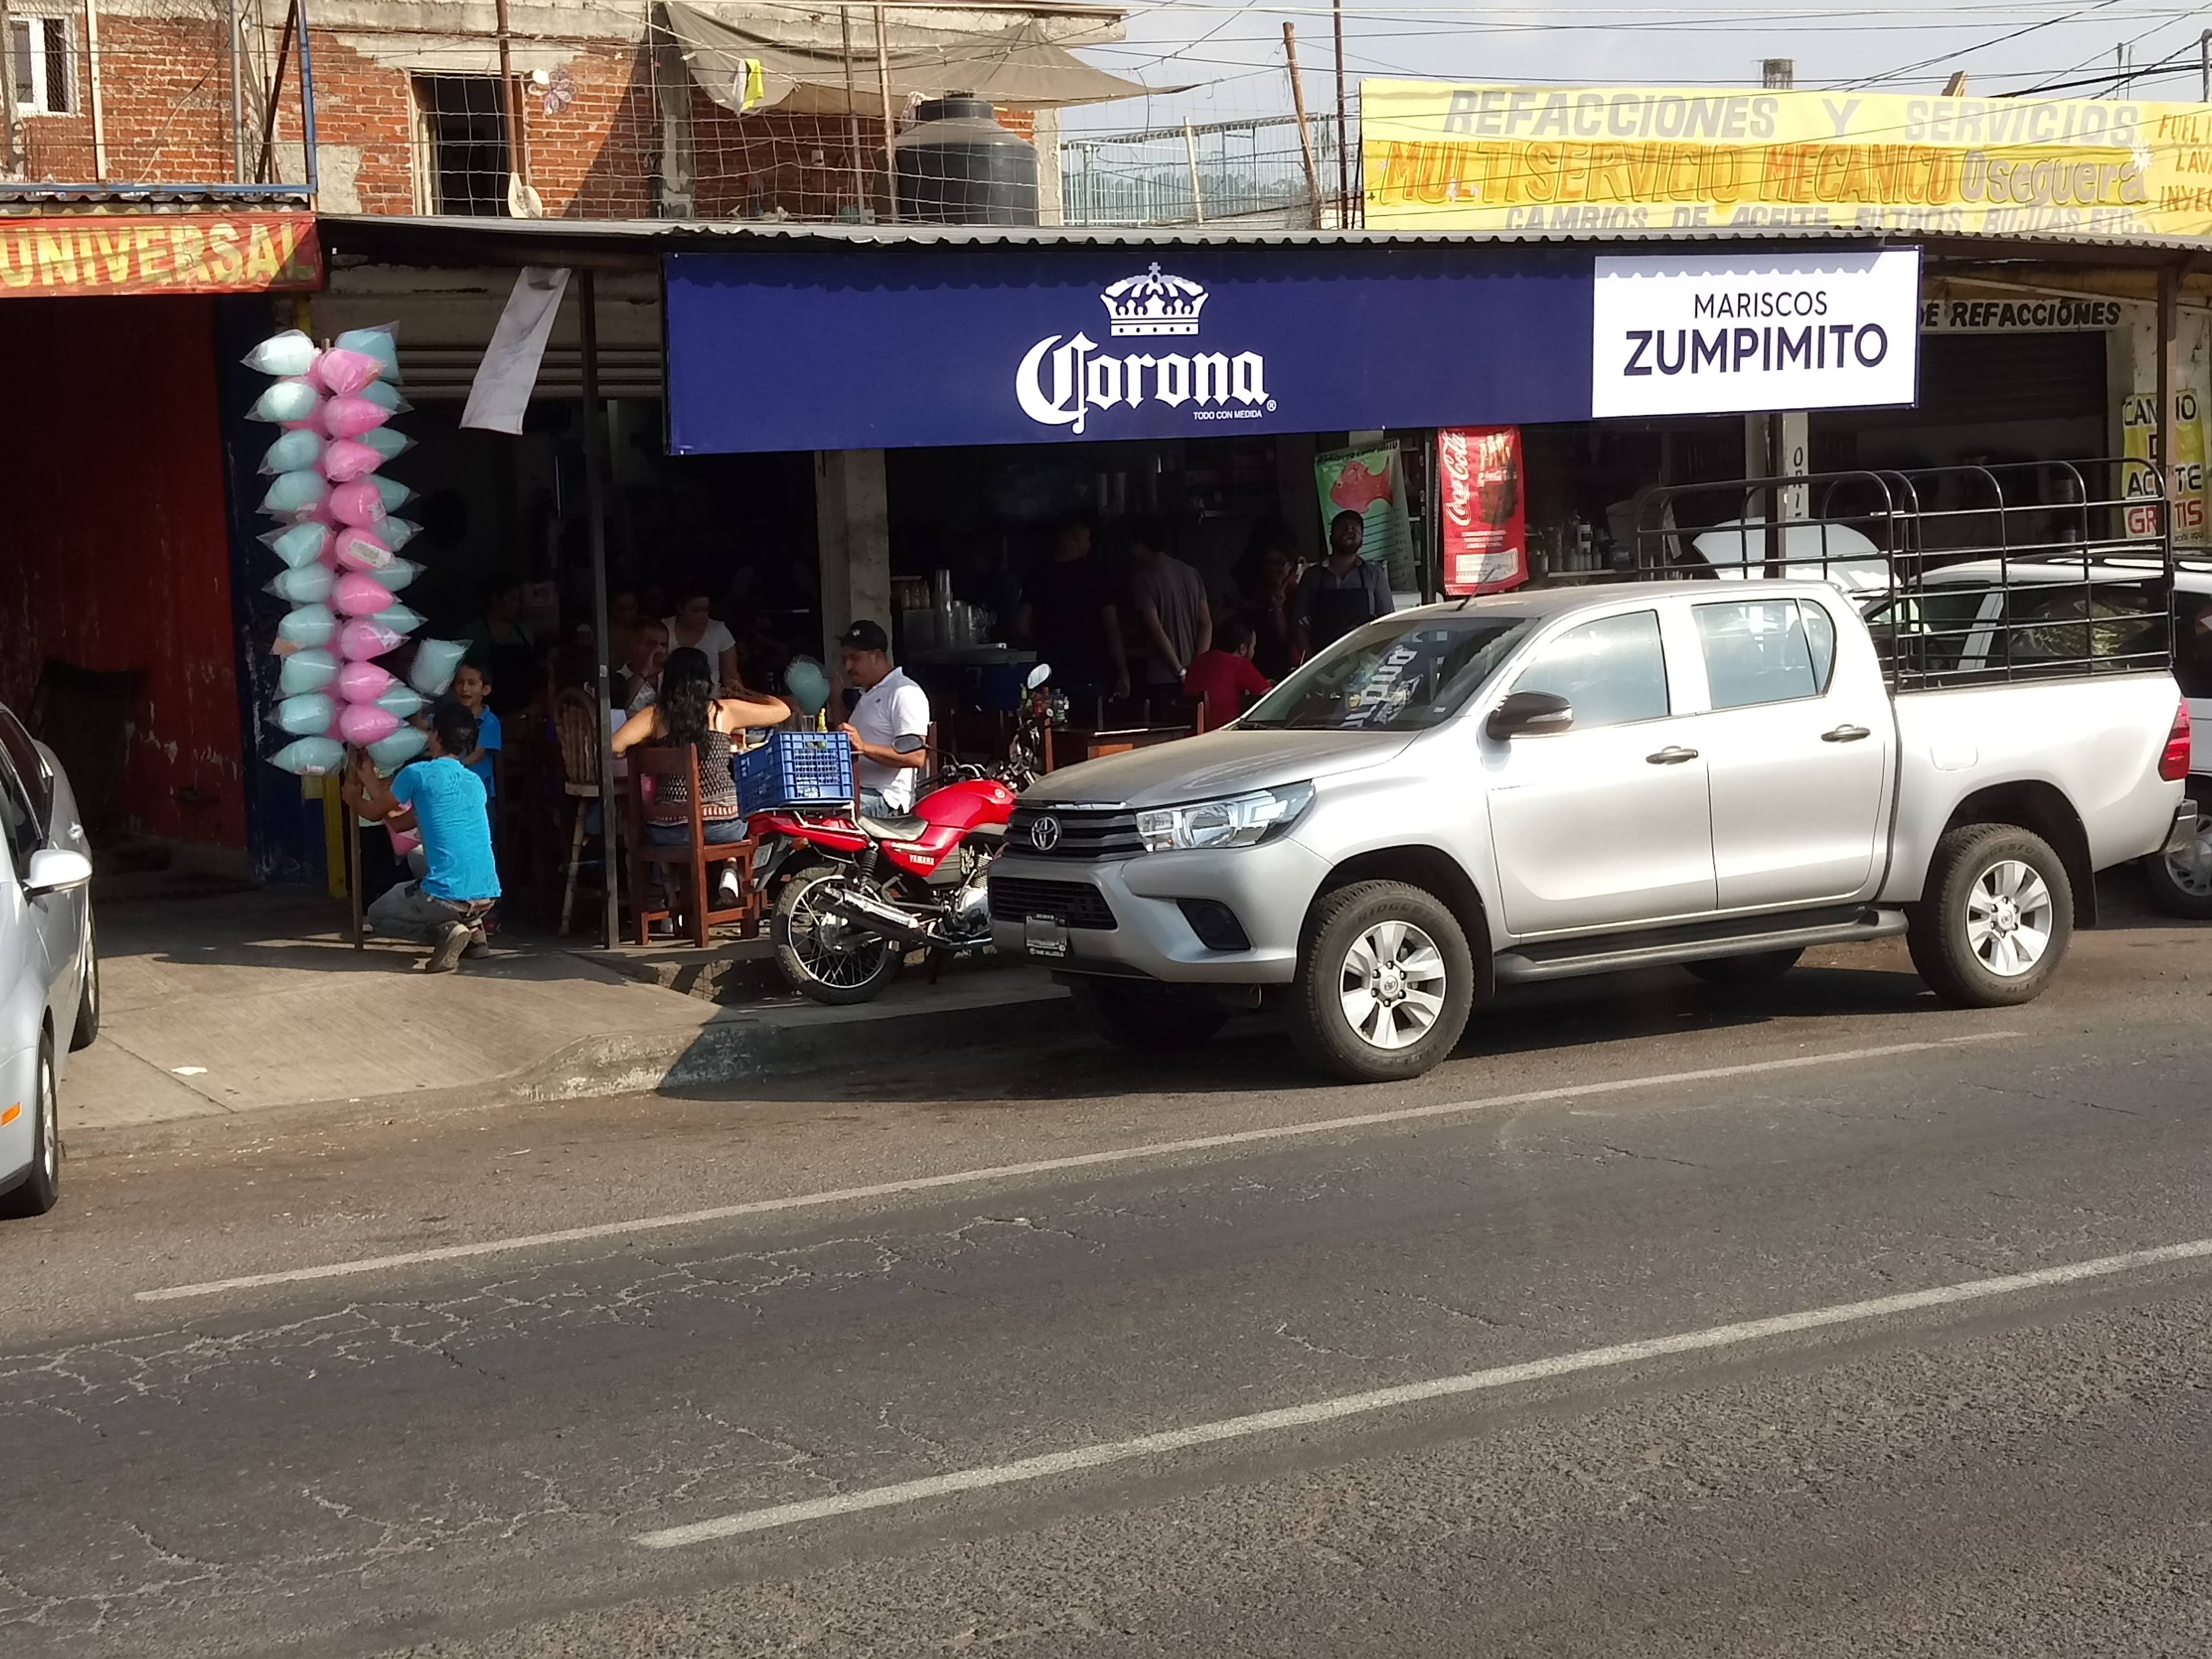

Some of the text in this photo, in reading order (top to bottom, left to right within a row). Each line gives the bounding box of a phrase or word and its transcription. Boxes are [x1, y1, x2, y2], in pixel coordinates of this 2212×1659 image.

[1442, 90, 2139, 148] REFACCIONES Y SERVICIOS
[2158, 114, 2200, 144] FUEL
[1380, 141, 2149, 207] MULTISERVICIO MECANICO Oseguera
[1506, 206, 1648, 229] CAMBIOS
[1672, 206, 1709, 228] DE
[1729, 206, 1829, 227] ACEITE
[0, 222, 316, 287] UNIVERSAL
[1694, 291, 1828, 318] MARISCOS
[1950, 302, 2121, 327] REFACCIONES
[1624, 323, 1888, 376] ZUMPIMITO
[1016, 331, 1269, 434] Corona
[1193, 409, 1263, 420] TODO CON MEDIDA
[2128, 500, 2203, 534] GRTIS
